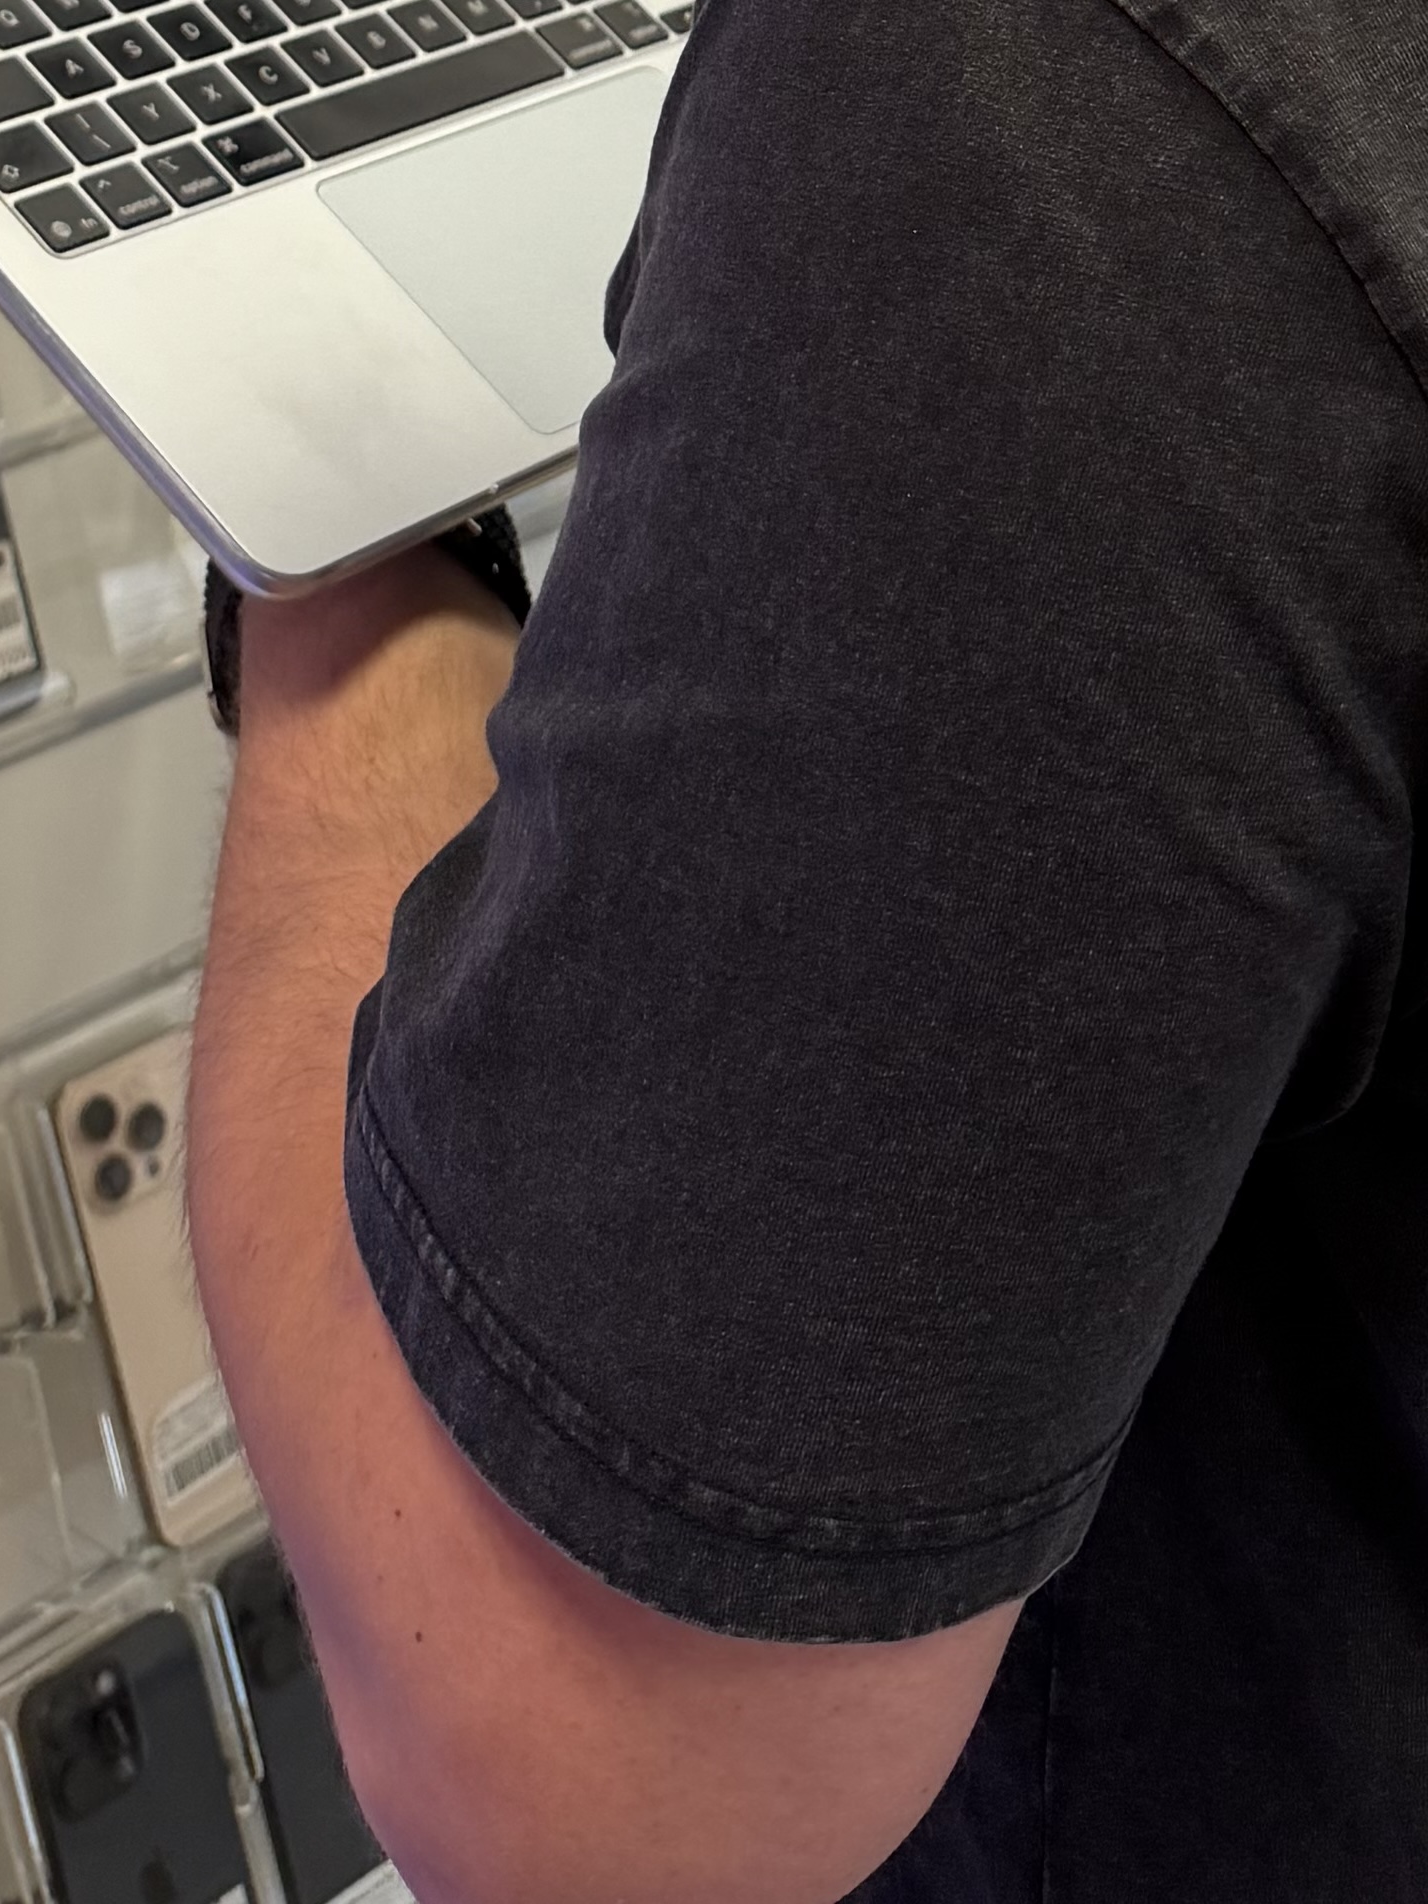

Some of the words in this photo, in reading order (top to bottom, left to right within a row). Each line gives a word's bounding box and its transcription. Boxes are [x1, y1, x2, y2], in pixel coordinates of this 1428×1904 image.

[64, 58, 85, 78] A
[122, 38, 143, 60] S
[178, 20, 201, 42] D
[236, 2, 254, 25] F
[140, 101, 160, 121] Y
[199, 82, 222, 103] X
[257, 64, 279, 85] C
[312, 47, 332, 67] V
